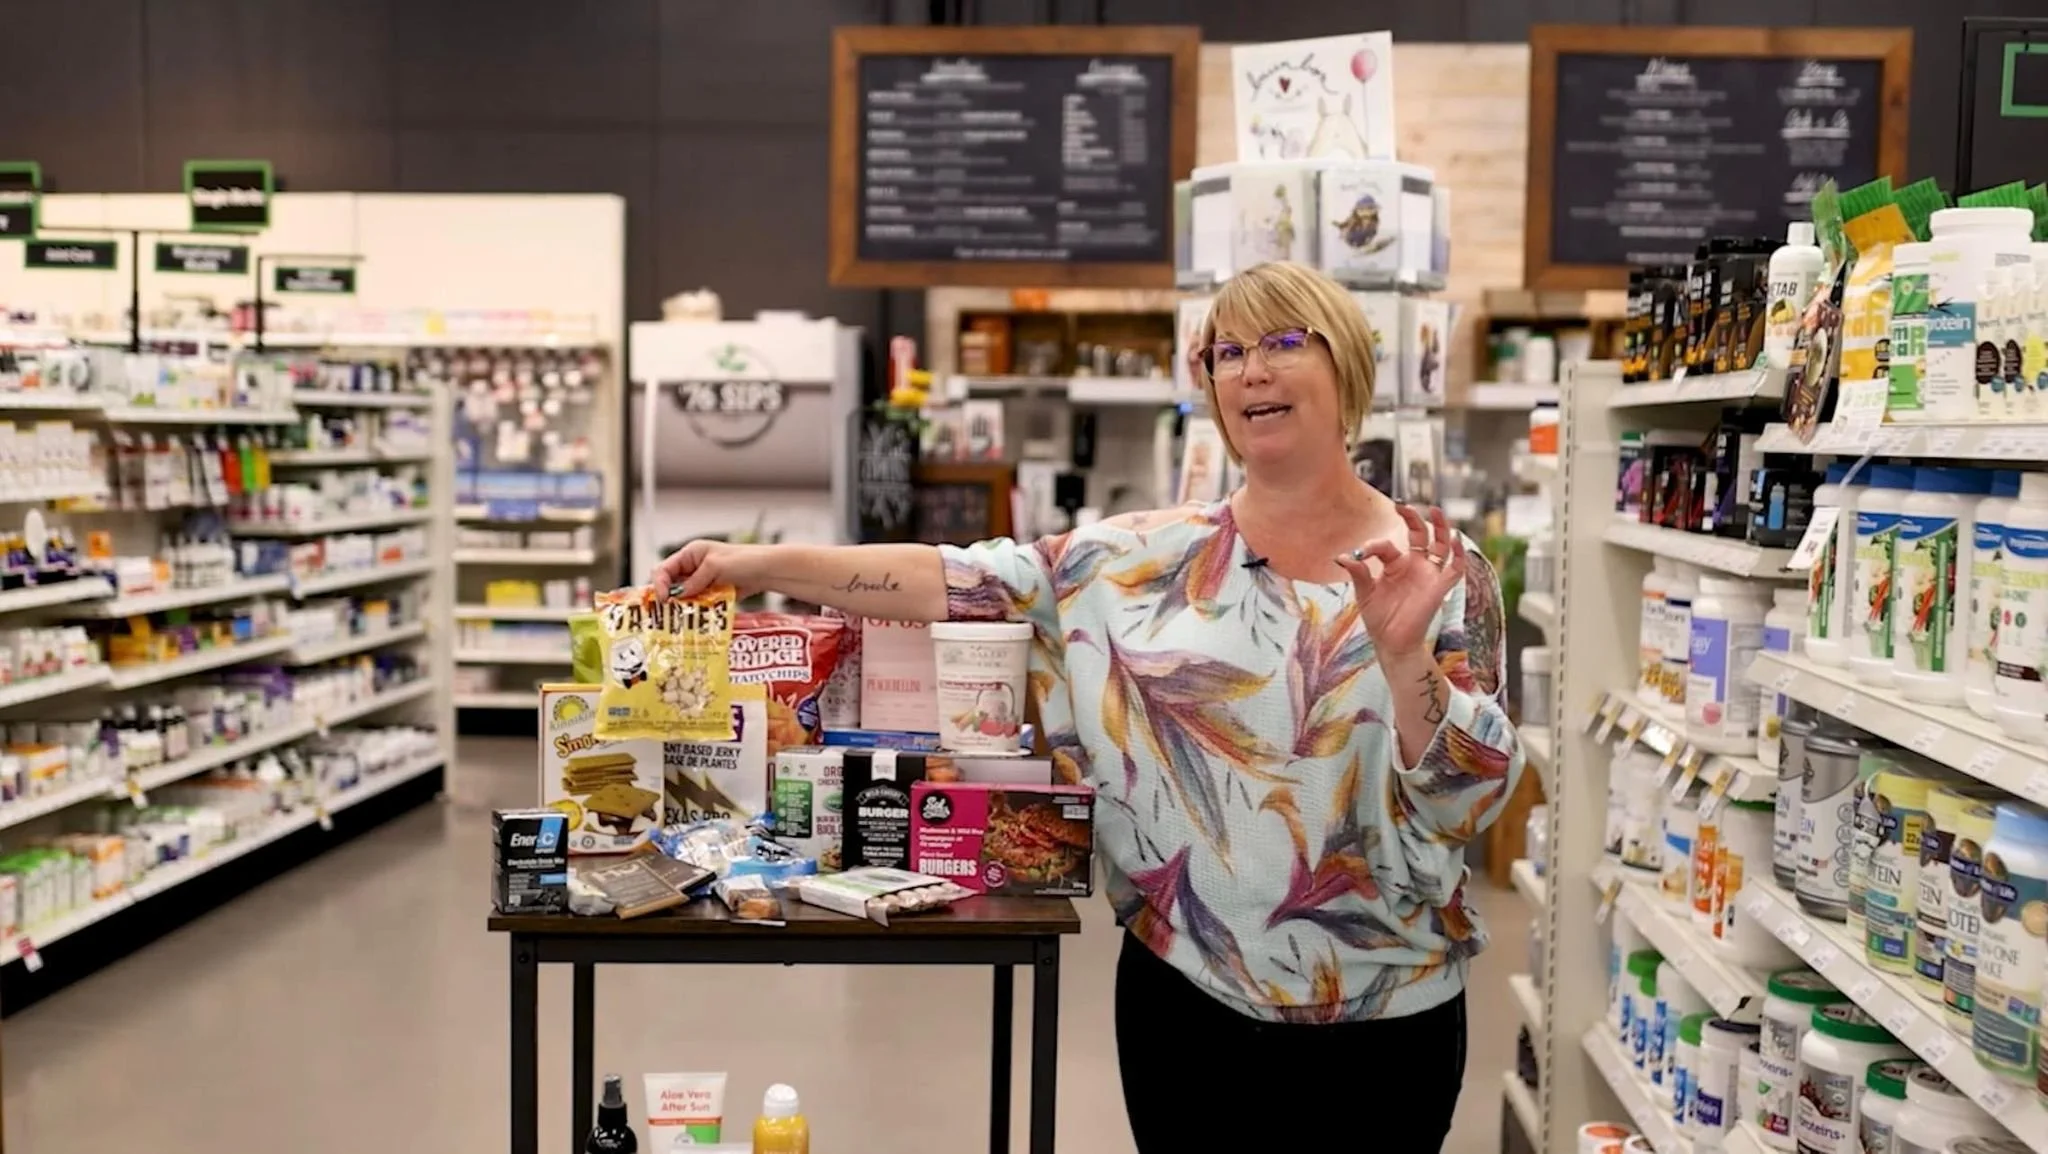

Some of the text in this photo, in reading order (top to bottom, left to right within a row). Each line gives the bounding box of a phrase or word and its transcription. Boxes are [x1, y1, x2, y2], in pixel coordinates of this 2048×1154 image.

[858, 806, 909, 819] BURGER
[918, 858, 977, 876] BURGERS
[660, 1089, 711, 1100] Aloe Vera
[660, 1101, 710, 1112] After Sun
